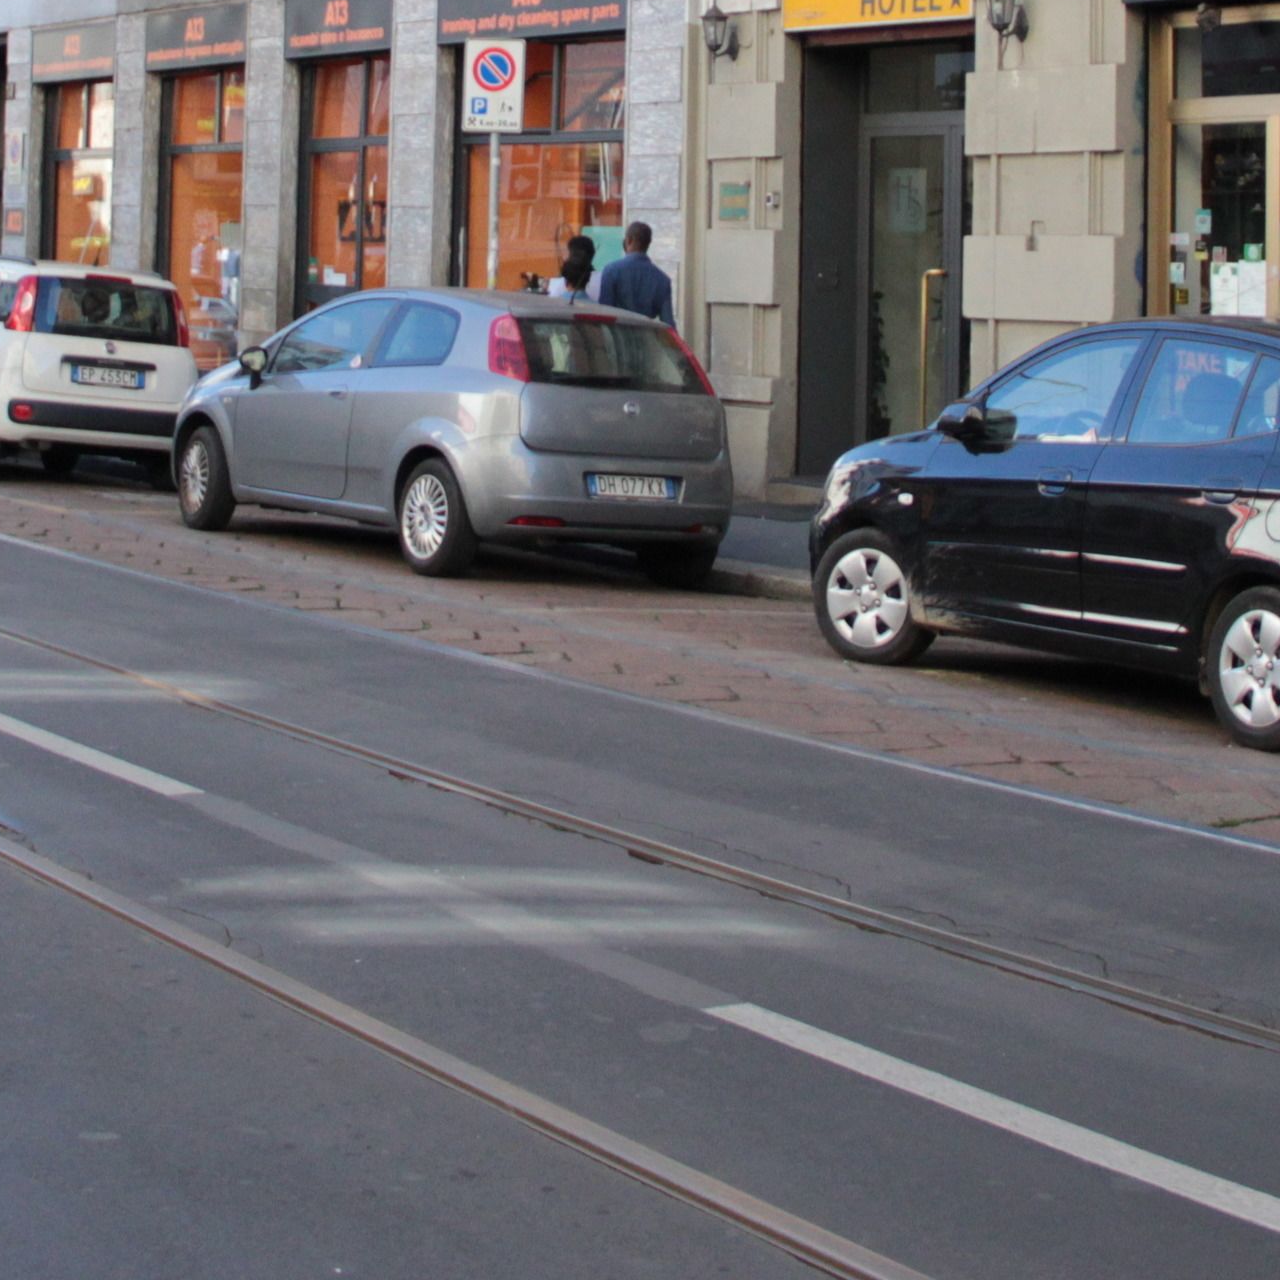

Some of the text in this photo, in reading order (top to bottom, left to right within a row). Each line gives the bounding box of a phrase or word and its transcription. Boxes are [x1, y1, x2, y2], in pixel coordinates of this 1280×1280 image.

[324, 0, 349, 26] A13
[477, 15, 497, 31] and
[498, 12, 515, 32] dry
[517, 8, 559, 28] cleaning
[561, 5, 590, 27] spare
[591, 2, 620, 24] parts
[183, 16, 206, 42] A13
[80, 367, 96, 380] EP
[1176, 349, 1222, 374] TAKE
[598, 476, 665, 496] DH 077KX
